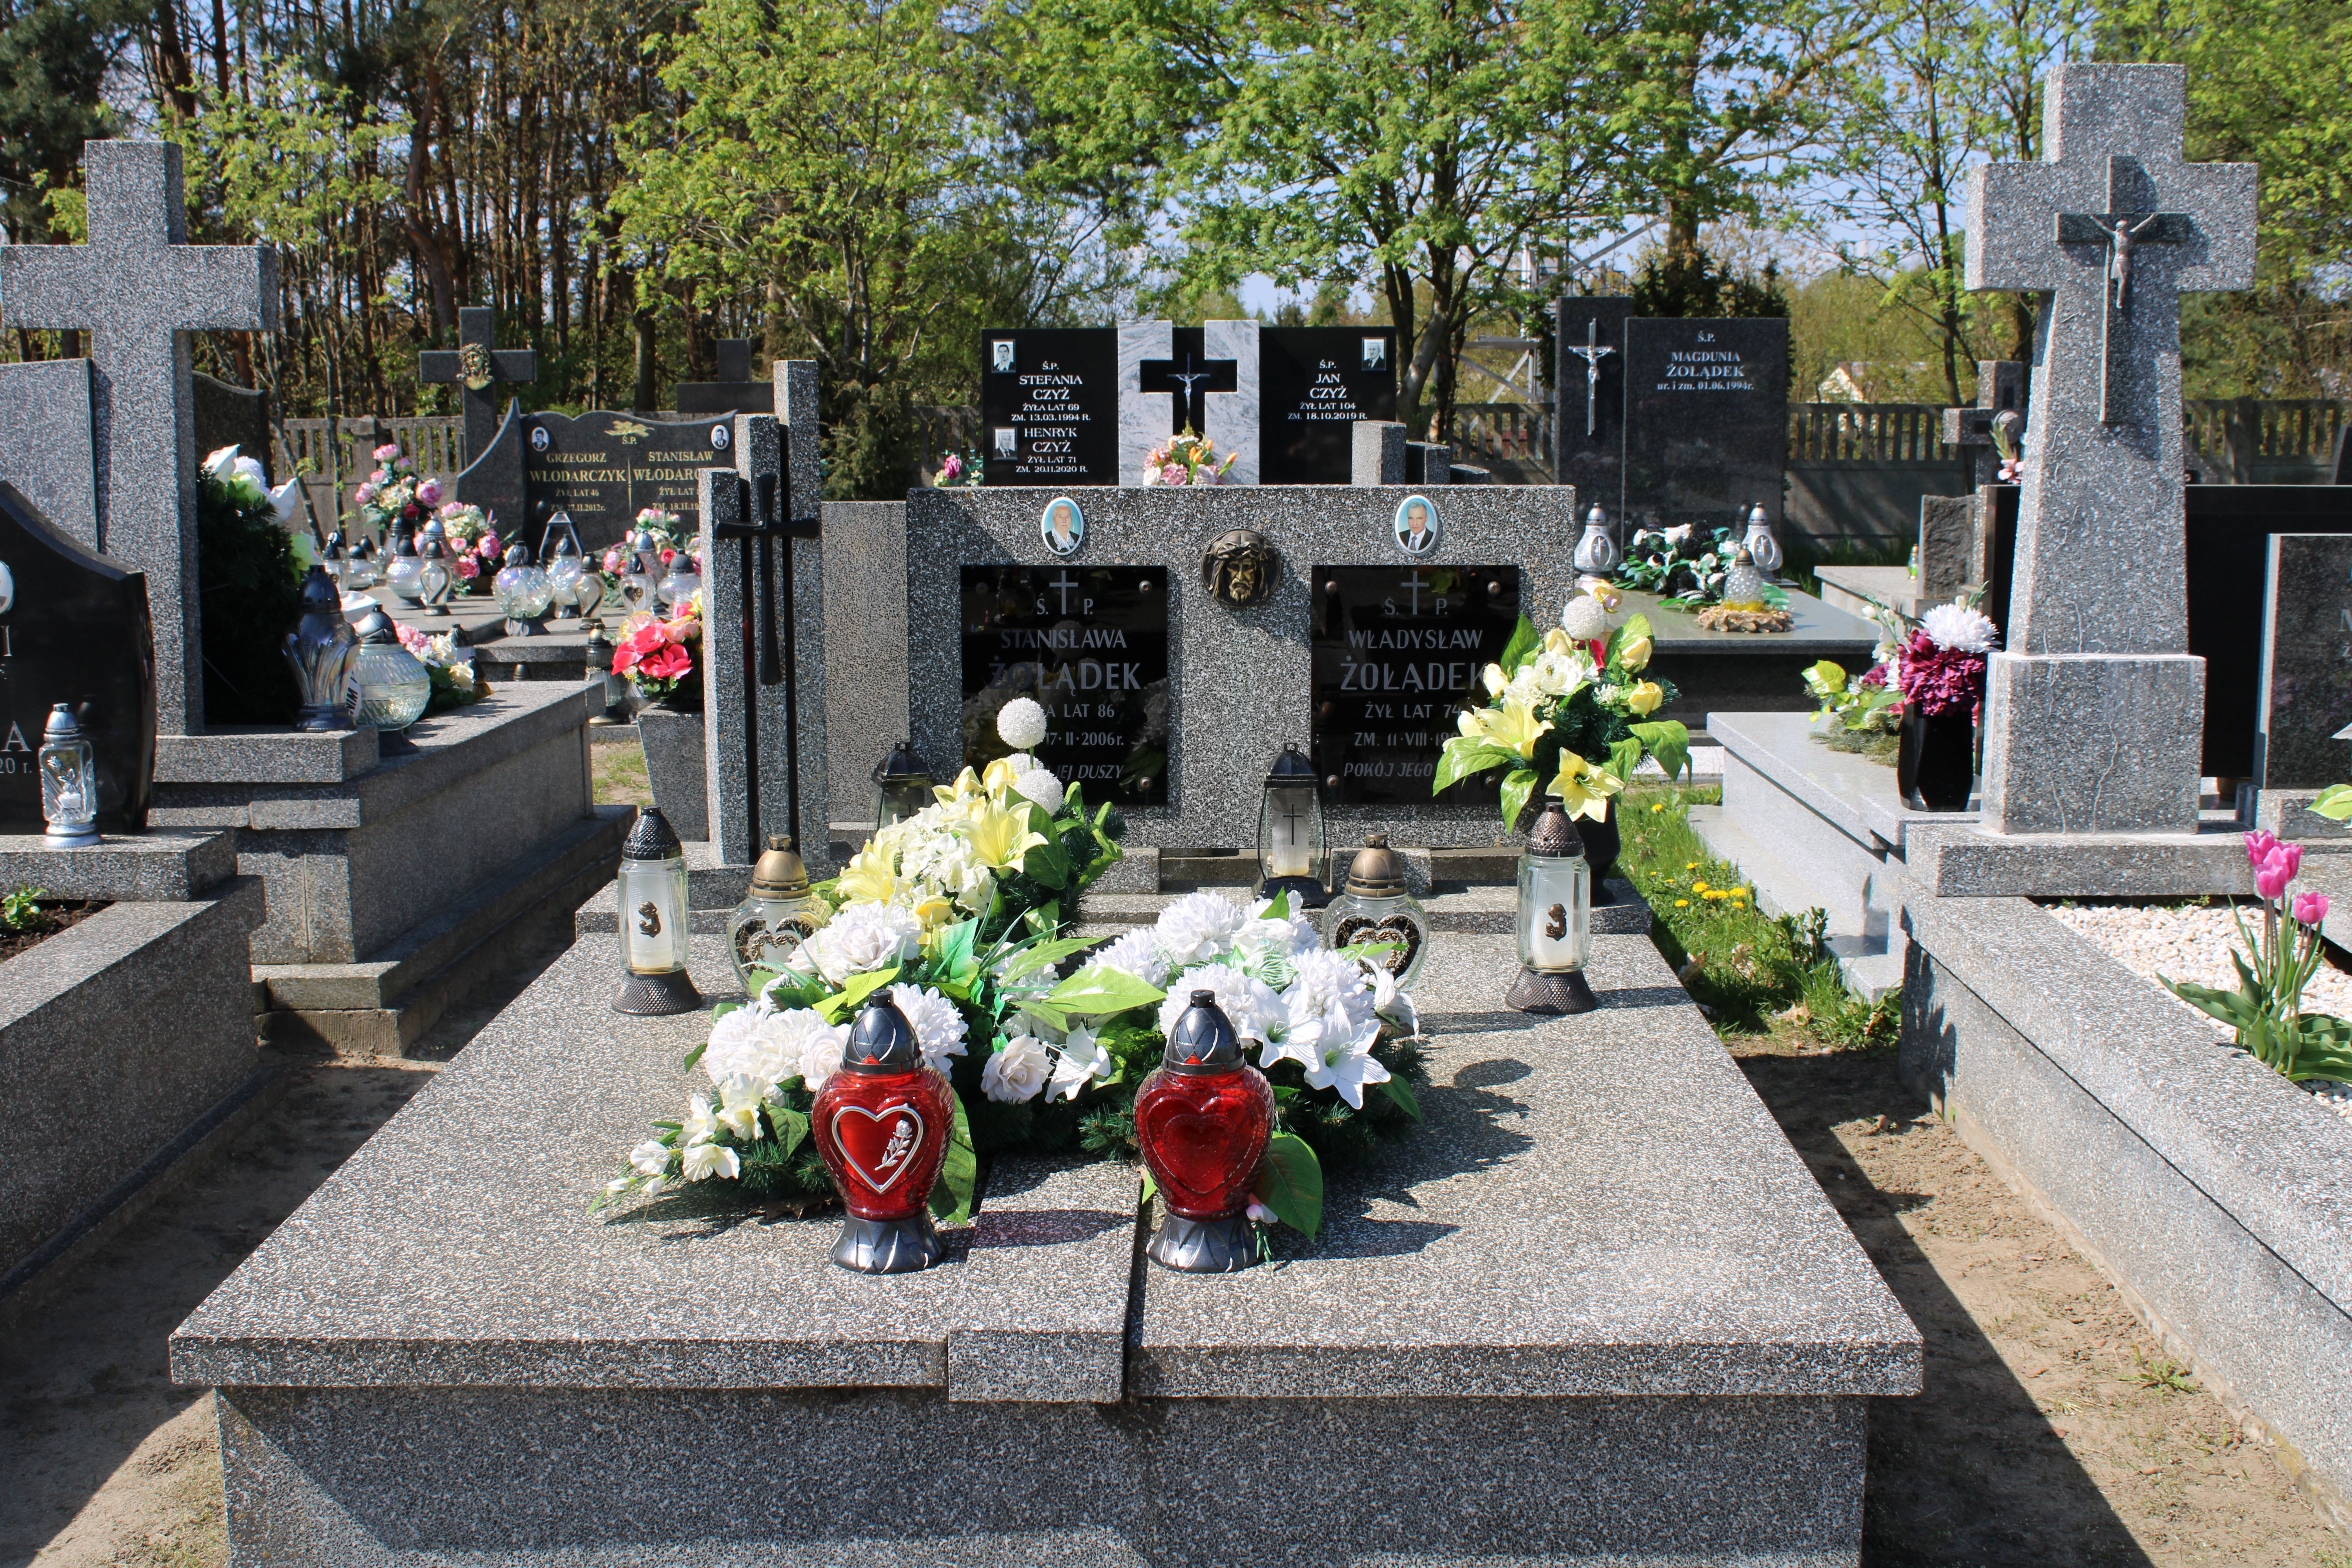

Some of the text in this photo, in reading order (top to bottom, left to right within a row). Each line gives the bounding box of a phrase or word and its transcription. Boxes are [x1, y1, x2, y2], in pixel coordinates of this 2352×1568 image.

[1697, 330, 1716, 342] Ś.P.
[1671, 351, 1741, 361] MAGDUNIA
[1042, 360, 1059, 370] Ś.P.
[1319, 359, 1337, 368] Ś.P.
[1666, 363, 1745, 379] ŻOŁĄDEK
[1019, 375, 1083, 385] STEFANIA
[1316, 373, 1341, 383] JAN
[1672, 381, 1677, 390] i
[1033, 387, 1070, 400] CZYŻ
[1309, 385, 1347, 399] CZYŻ
[1023, 403, 1046, 411] ŻYŁA
[1299, 401, 1317, 410] ŻYŁ
[1024, 428, 1078, 437] HENRYK
[622, 435, 637, 445] Ś.P.
[1032, 439, 1071, 452] CZYŻ
[546, 452, 607, 463] GRZEGORZ
[648, 451, 714, 462] STANISŁAW
[1027, 455, 1045, 463] ŻYŁ
[659, 486, 675, 495] ŻYŁ
[652, 502, 668, 510] ZM.
[1036, 593, 1093, 615] Ś. P.
[1384, 596, 1448, 615] Ś. P.
[1001, 630, 1127, 649] STANISŁAWA
[1348, 630, 1483, 649] WŁADYSŁAW
[988, 655, 1141, 697] ŻOŁĄDEK
[1340, 655, 1487, 693] ŻOŁĄDEK
[1064, 704, 1090, 717] LAT
[1098, 704, 1115, 718] 86
[1365, 701, 1461, 718] ŻYŁ LAT 74
[1354, 732, 1380, 746] ZM.
[1078, 765, 1125, 779] DUSZY
[1344, 760, 1433, 777] POKÓJ JEGO
